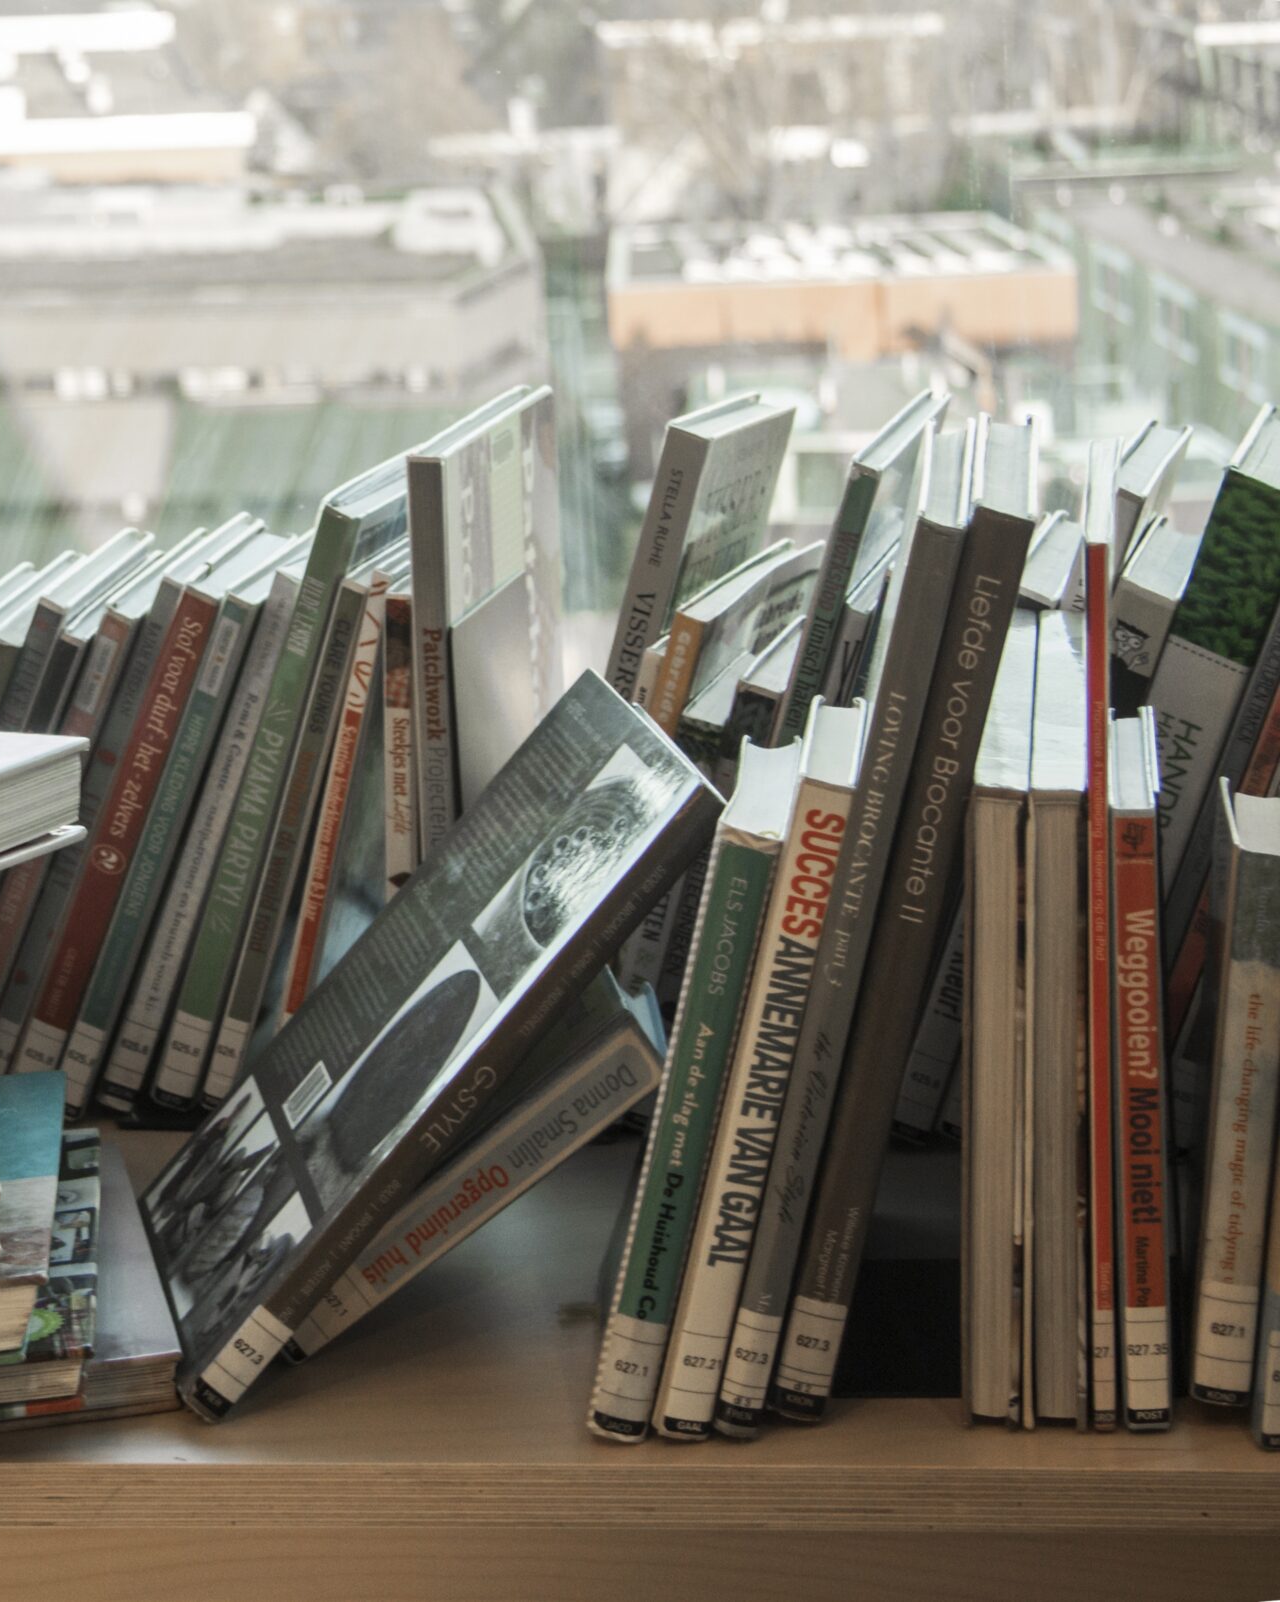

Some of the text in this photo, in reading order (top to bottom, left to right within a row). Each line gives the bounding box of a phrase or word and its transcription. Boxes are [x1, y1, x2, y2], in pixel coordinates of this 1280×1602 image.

[659, 468, 685, 523] STELLA
[647, 526, 669, 569] RUHE
[174, 616, 204, 660] Stof
[329, 618, 352, 673] CLARE
[786, 532, 859, 729] Workshop Tunisch haken
[161, 655, 187, 693] voor
[147, 694, 179, 740] durf
[238, 692, 259, 726] Remi
[310, 676, 339, 735] YOUNGS
[132, 741, 163, 773] het
[388, 717, 411, 766] Steekjes
[423, 628, 450, 844] Patchwork Projecten
[871, 691, 907, 783] LOVING
[899, 575, 1002, 924] Liefde voor Brocante II
[241, 727, 285, 817] PYJAMA
[392, 768, 410, 798] met
[110, 780, 144, 838] zelvers
[123, 713, 207, 918] HIPPE KLEDING VOOR JONGENS
[216, 822, 259, 908] PARTY!
[845, 788, 885, 920] BROCANTE
[1094, 848, 1105, 896] tekenen
[725, 876, 749, 913] ELS
[708, 915, 739, 997] JACOBS
[1094, 934, 1105, 961] iPad
[1249, 992, 1264, 1020] the
[691, 1021, 716, 1062] Aan
[706, 807, 848, 1269] SUCCES ANNEMARIE VAN GAAL
[576, 1063, 639, 1117] Donna
[686, 1064, 707, 1089] de
[1119, 908, 1162, 1226] Weggooien? Mooi niet!
[1232, 1024, 1262, 1134] life-changing
[420, 1066, 498, 1151] G-STYLE
[672, 1093, 700, 1128] slag
[508, 1114, 580, 1171] Smallin
[669, 1131, 689, 1168] met
[1228, 1136, 1249, 1185] magic
[403, 1163, 511, 1258] Opgeruimd
[664, 1172, 685, 1202] De
[360, 1245, 411, 1287] huis
[642, 1204, 676, 1293] Huishoud
[1220, 1209, 1246, 1275] tidying
[232, 1337, 266, 1366] 627.3
[795, 1333, 831, 1352] 627.3
[1209, 1321, 1246, 1339] 627.1
[613, 1358, 650, 1378] 627.1
[734, 1346, 770, 1366] 627.3
[1135, 1410, 1165, 1421] POST
